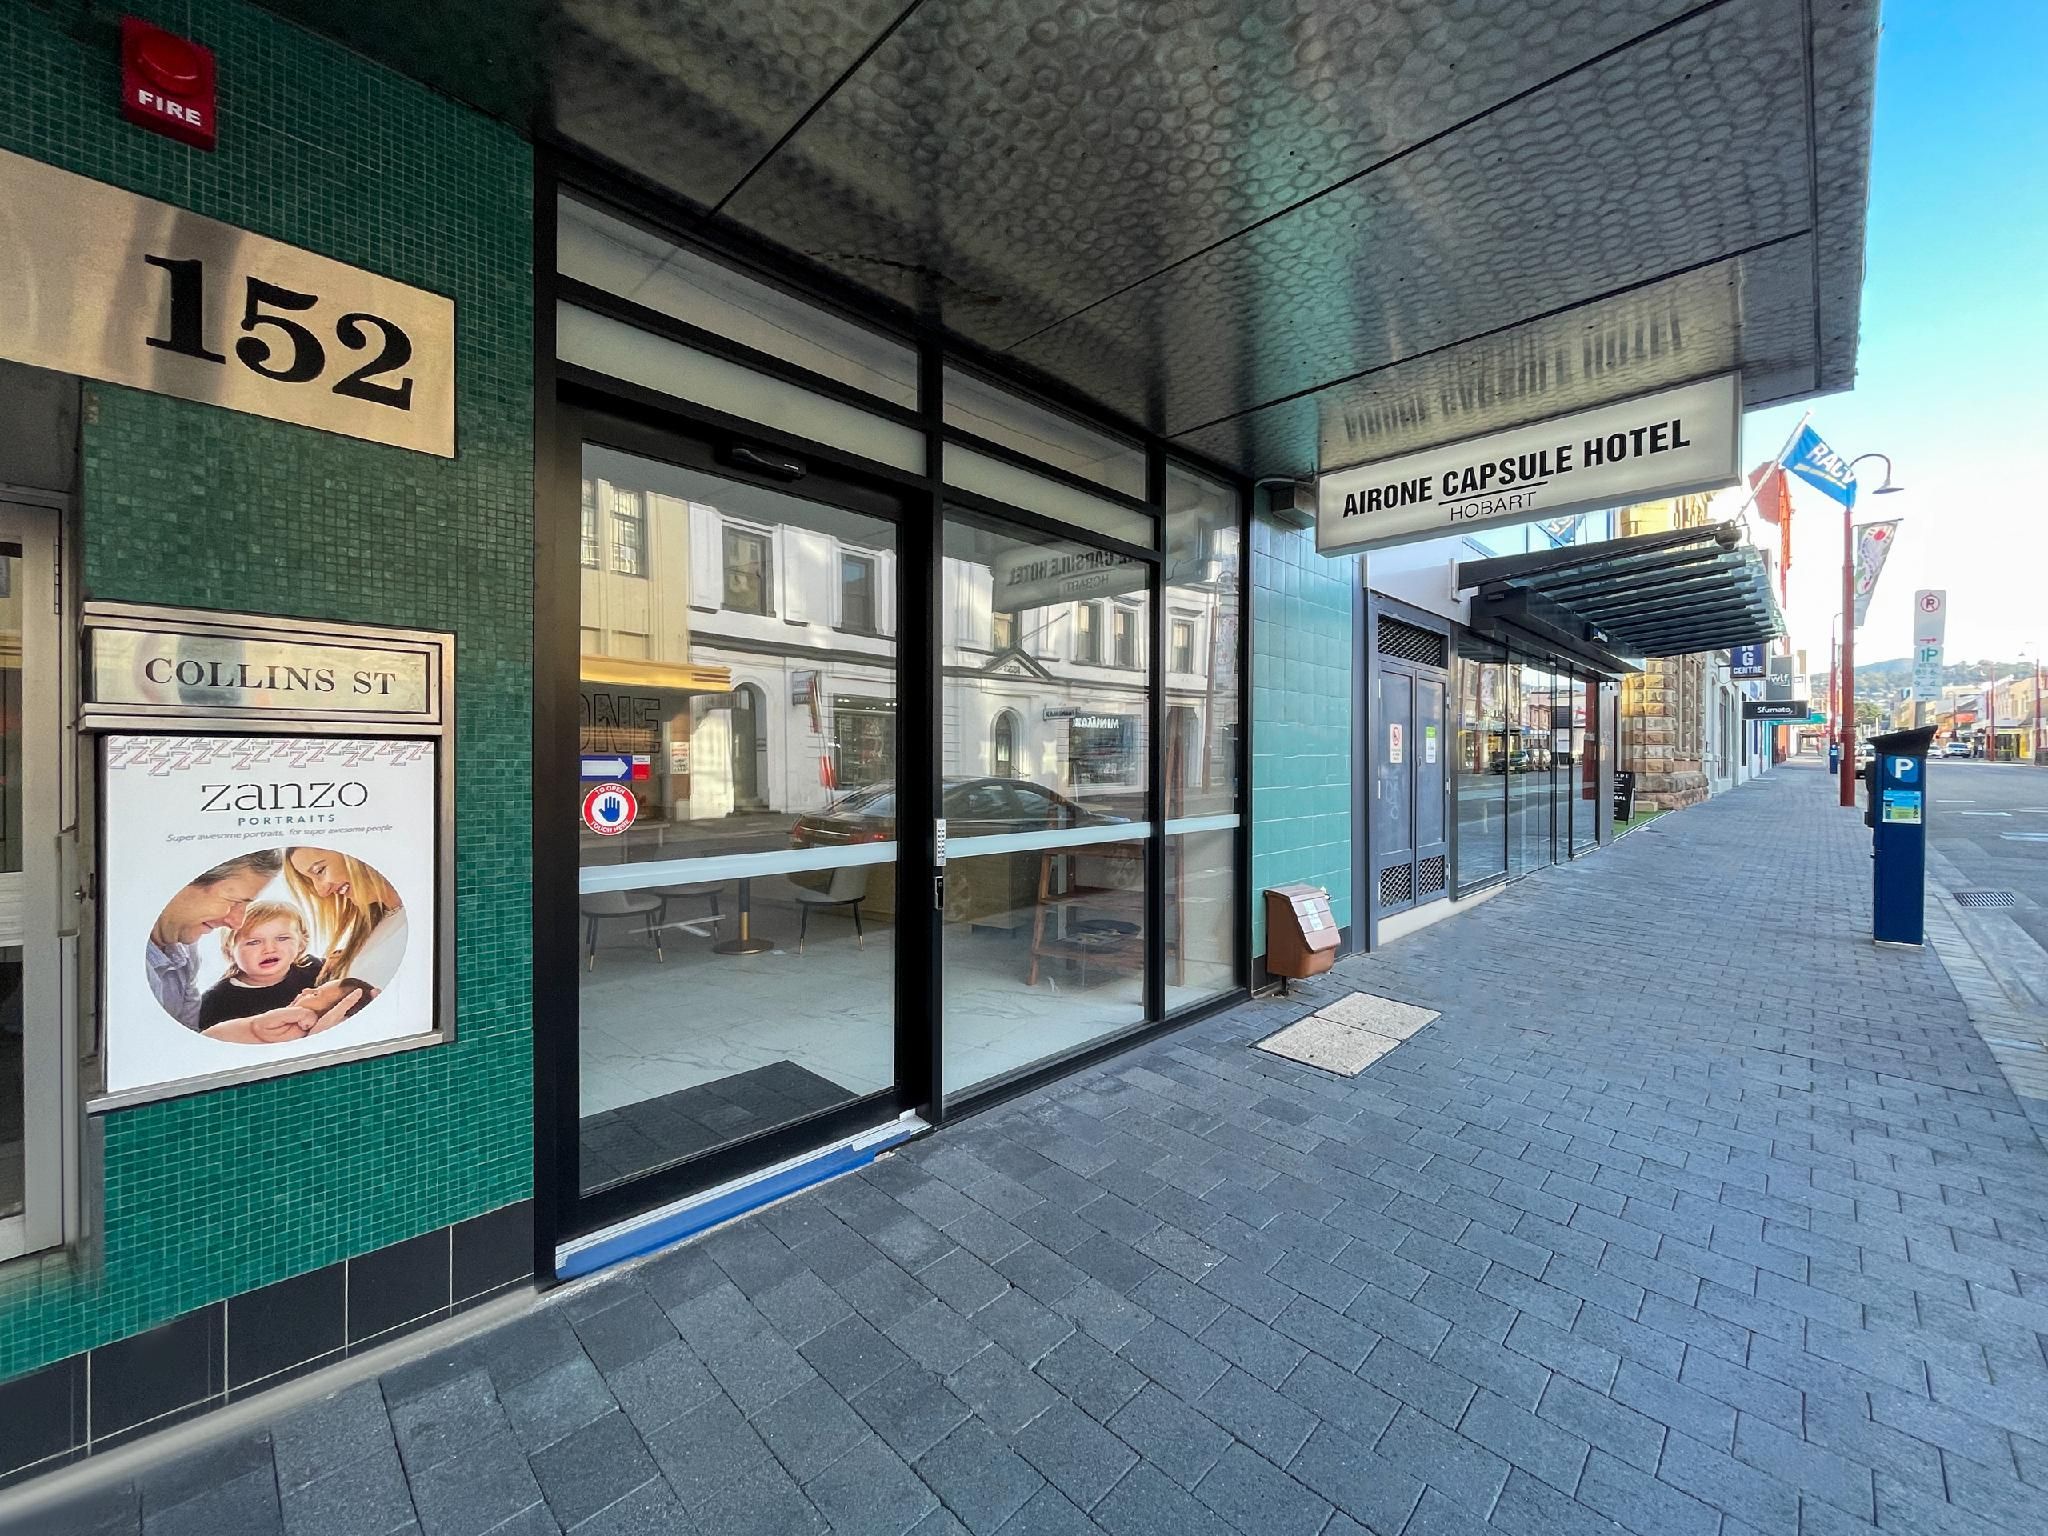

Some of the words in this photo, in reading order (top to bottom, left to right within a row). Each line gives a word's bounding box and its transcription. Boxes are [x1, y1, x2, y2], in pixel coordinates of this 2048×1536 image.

[138, 89, 202, 127] FIRE
[144, 254, 413, 411] 152
[1343, 475, 1433, 518] AIRONE
[1442, 444, 1573, 497] CAPSULE
[1583, 419, 1691, 468] HOTEL
[1450, 491, 1536, 521] HOBART
[145, 657, 335, 692] COLLINS
[353, 671, 396, 695] ST
[1733, 666, 1763, 674] CENTRE
[580, 693, 661, 753] NE
[1895, 758, 1914, 779] P
[200, 781, 369, 812] zanzo
[238, 814, 336, 826] PORTRAITS
[166, 834, 196, 843] Super
